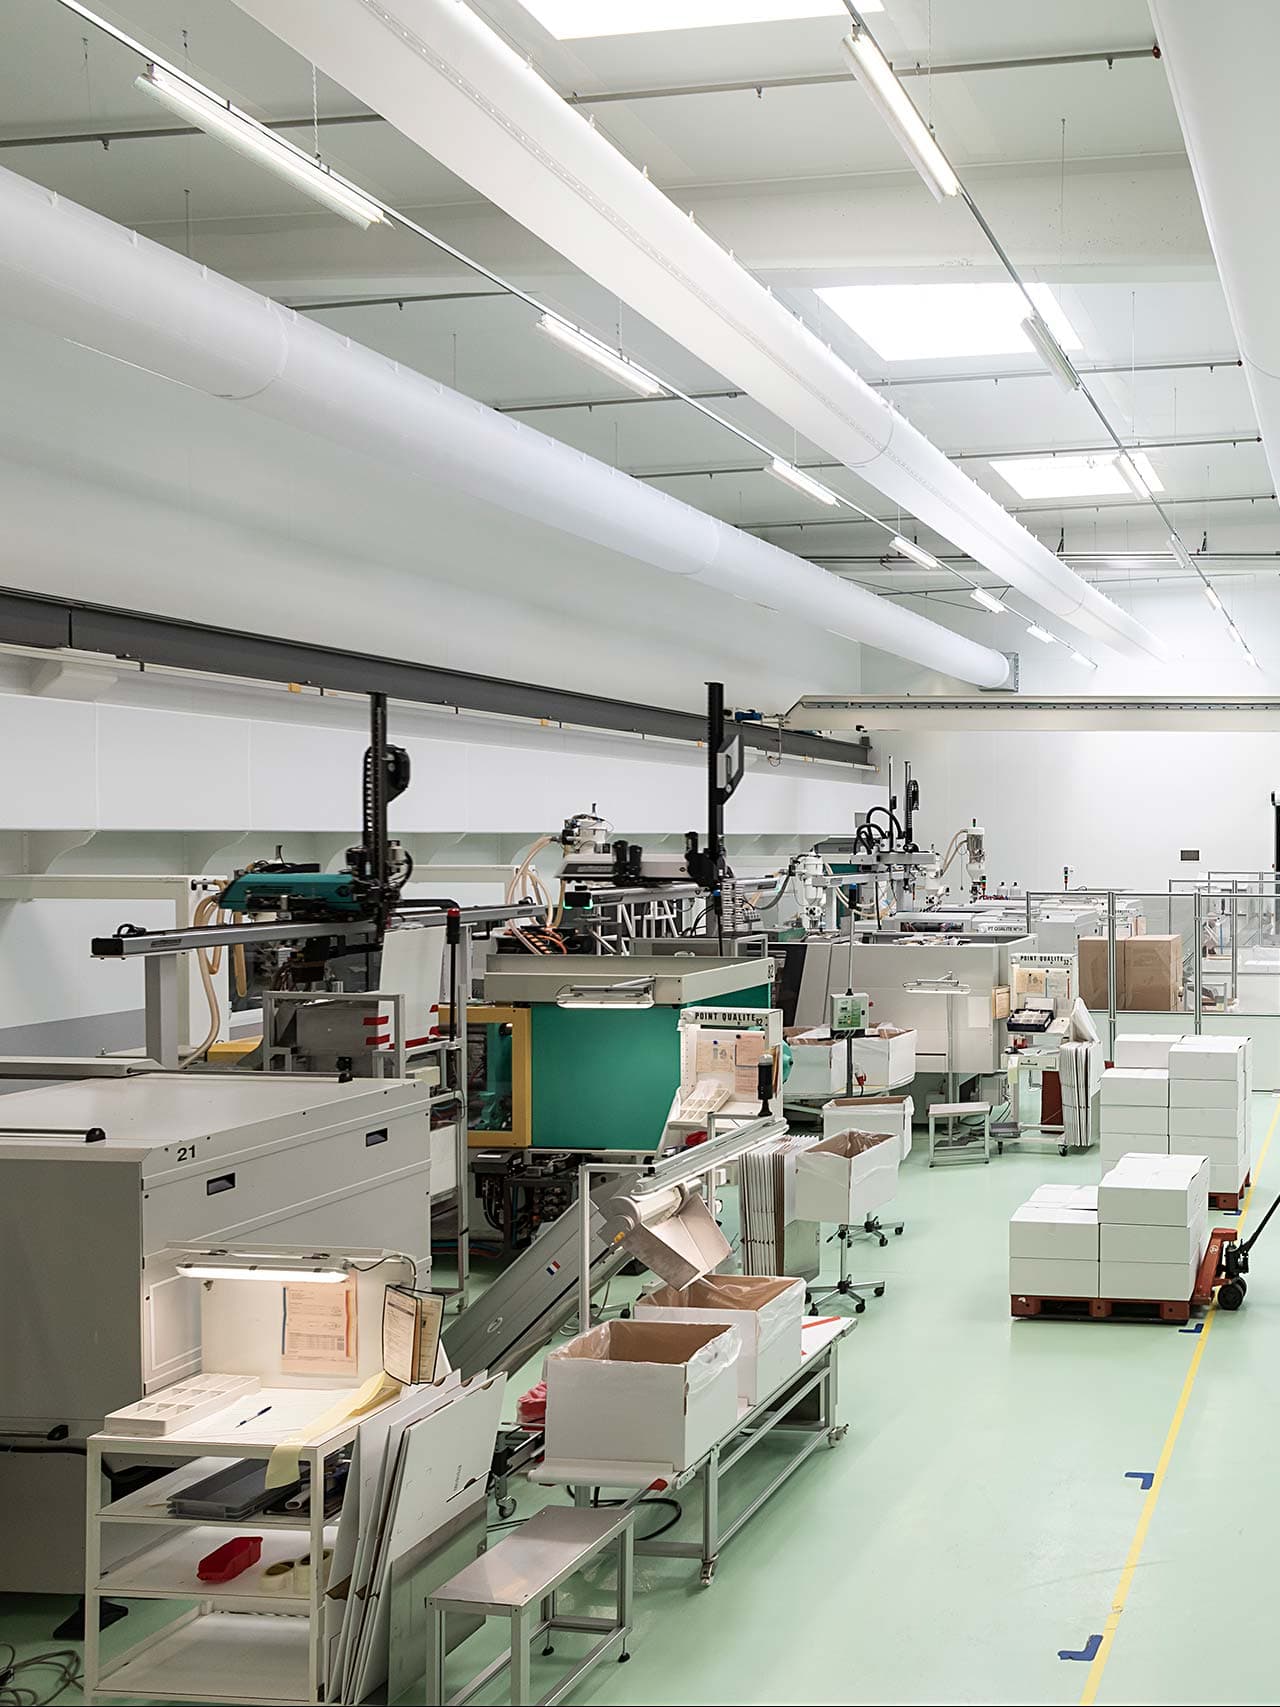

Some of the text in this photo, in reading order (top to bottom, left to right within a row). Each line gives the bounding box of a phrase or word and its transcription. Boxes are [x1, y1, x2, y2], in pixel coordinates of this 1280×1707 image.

[694, 1012, 756, 1022] POINT QUALITE
[176, 1144, 196, 1162] 21
